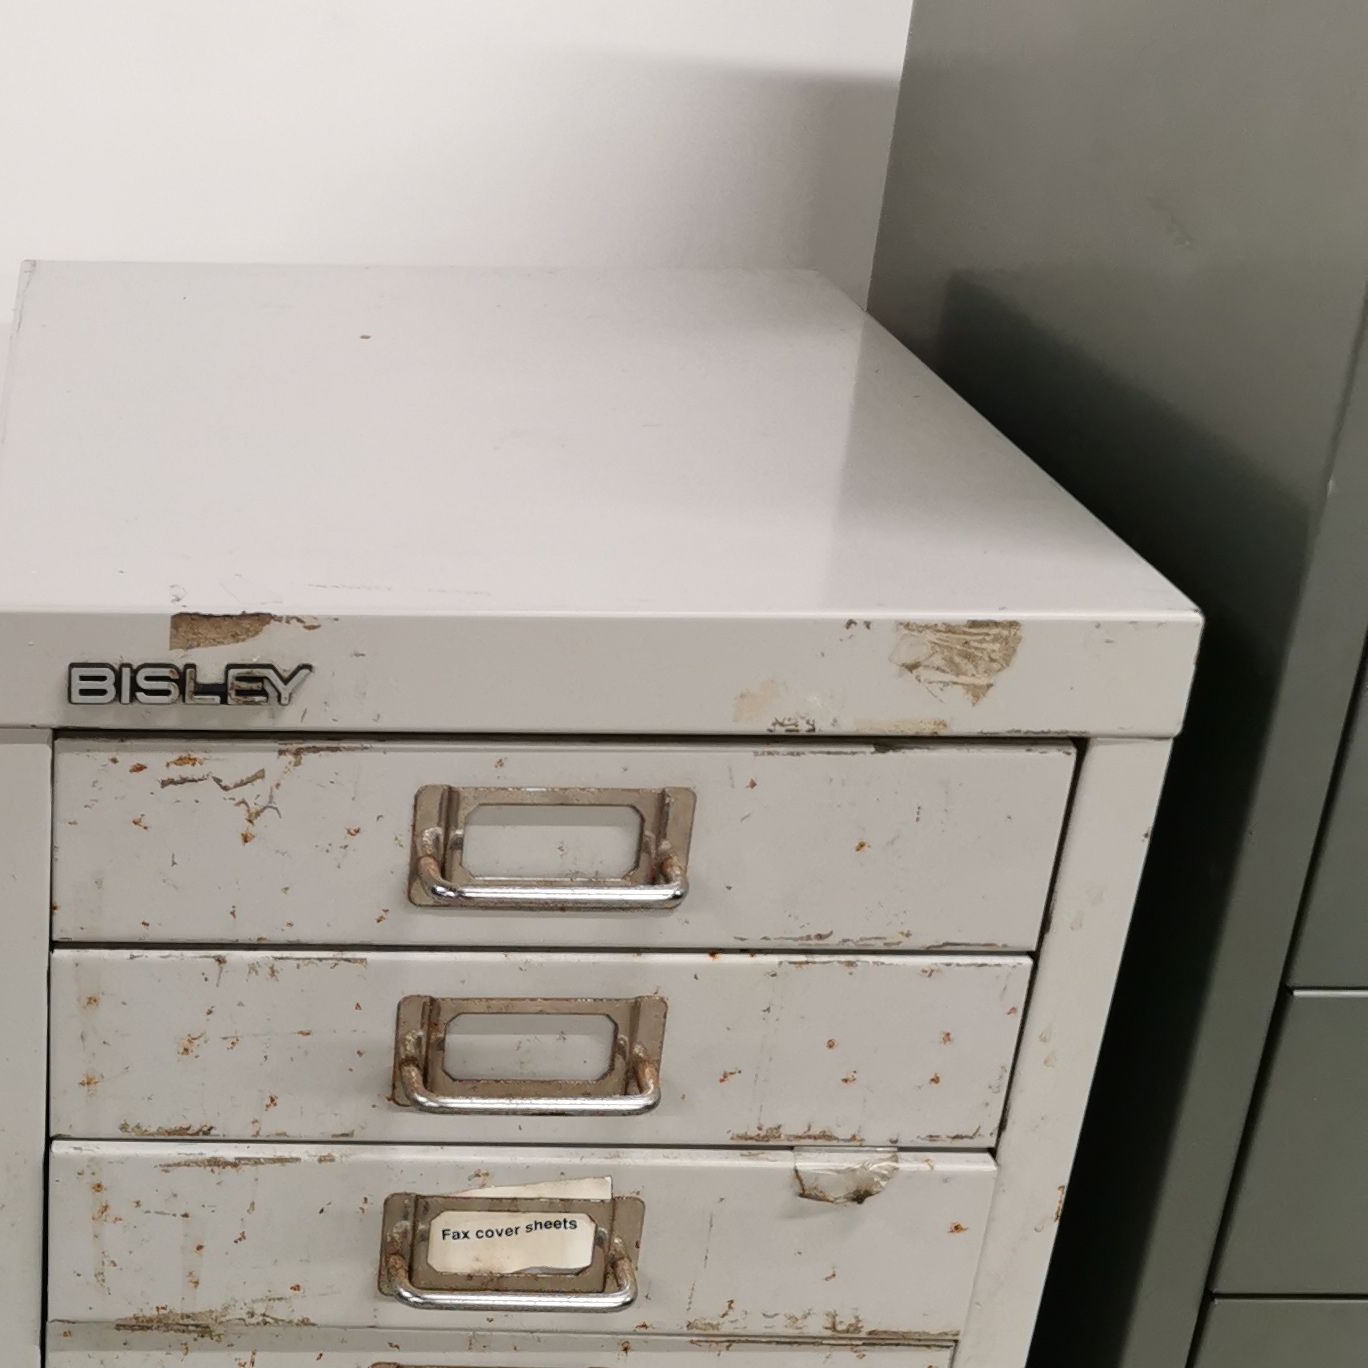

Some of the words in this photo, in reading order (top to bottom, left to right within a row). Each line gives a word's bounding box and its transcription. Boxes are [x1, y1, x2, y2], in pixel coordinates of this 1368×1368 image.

[68, 663, 313, 705] BISLEY
[441, 1228, 470, 1241] Fax
[475, 1226, 521, 1240] cover
[524, 1217, 578, 1233] sheets
